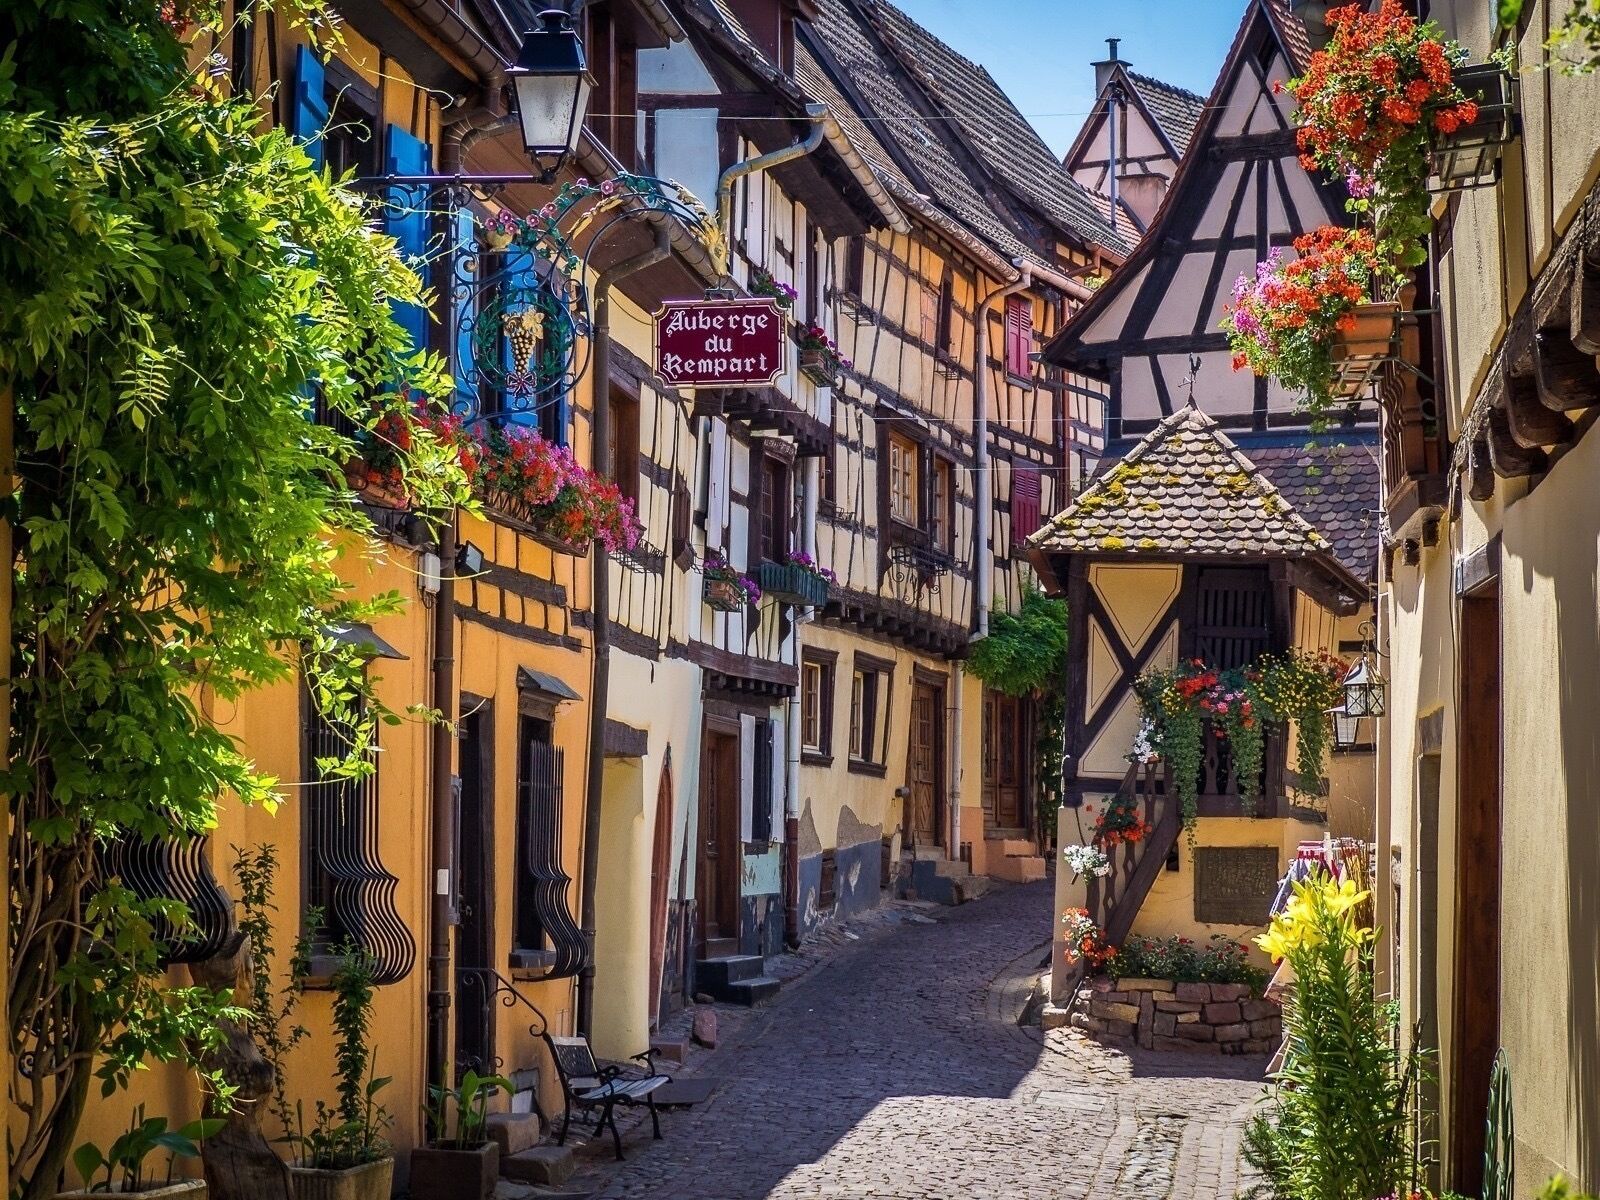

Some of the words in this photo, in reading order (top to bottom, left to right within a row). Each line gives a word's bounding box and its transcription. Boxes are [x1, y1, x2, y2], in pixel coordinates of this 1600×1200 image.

[666, 310, 768, 337] Auberge
[704, 333, 733, 352] du
[662, 353, 768, 379] Rempart
